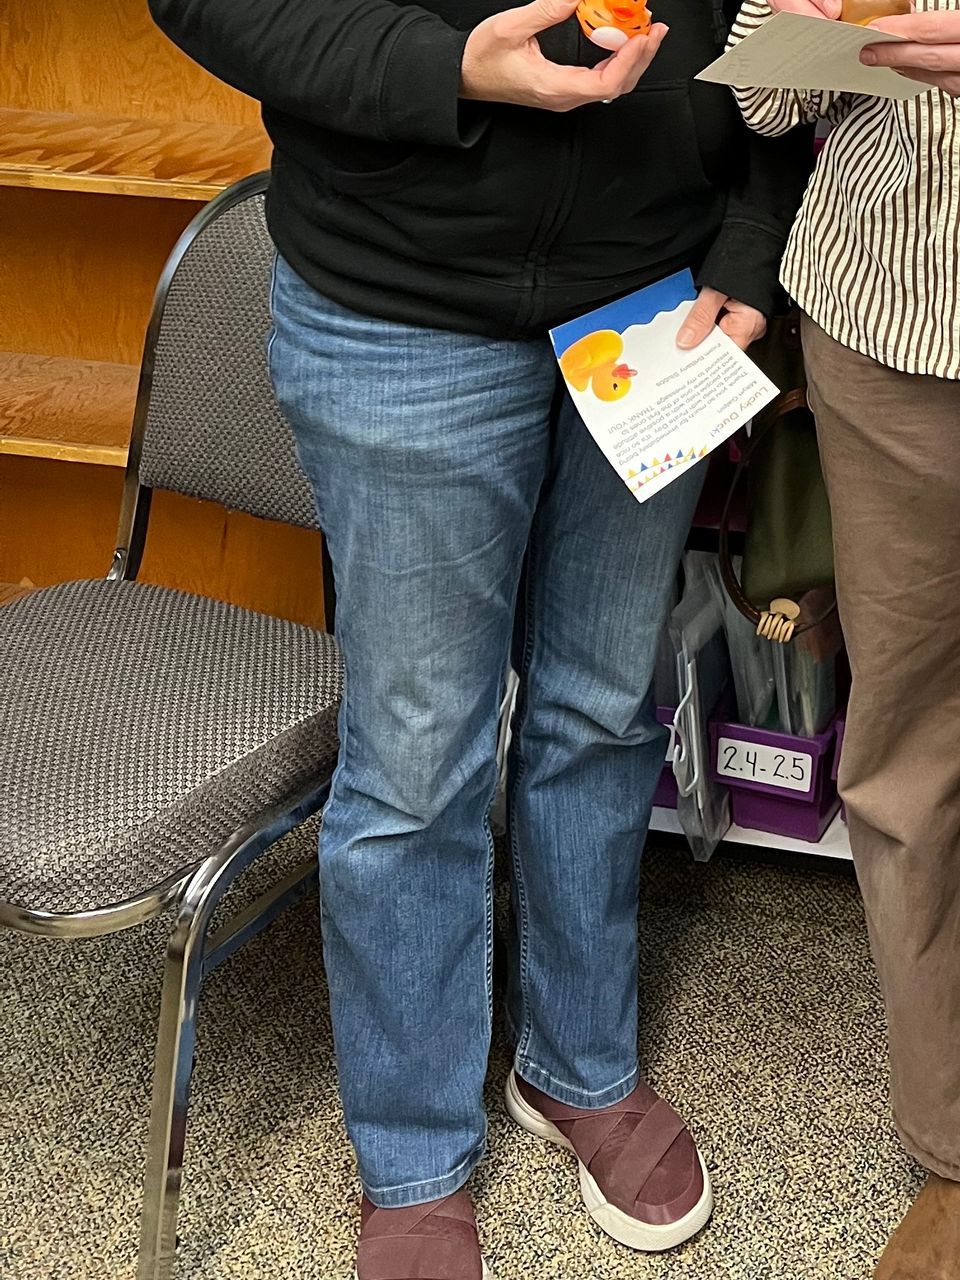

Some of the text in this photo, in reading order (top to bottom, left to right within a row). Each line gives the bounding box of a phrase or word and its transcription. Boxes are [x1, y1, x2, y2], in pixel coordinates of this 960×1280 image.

[737, 386, 768, 412] Lucky
[627, 405, 653, 422] THANK
[708, 411, 739, 437] Duck!
